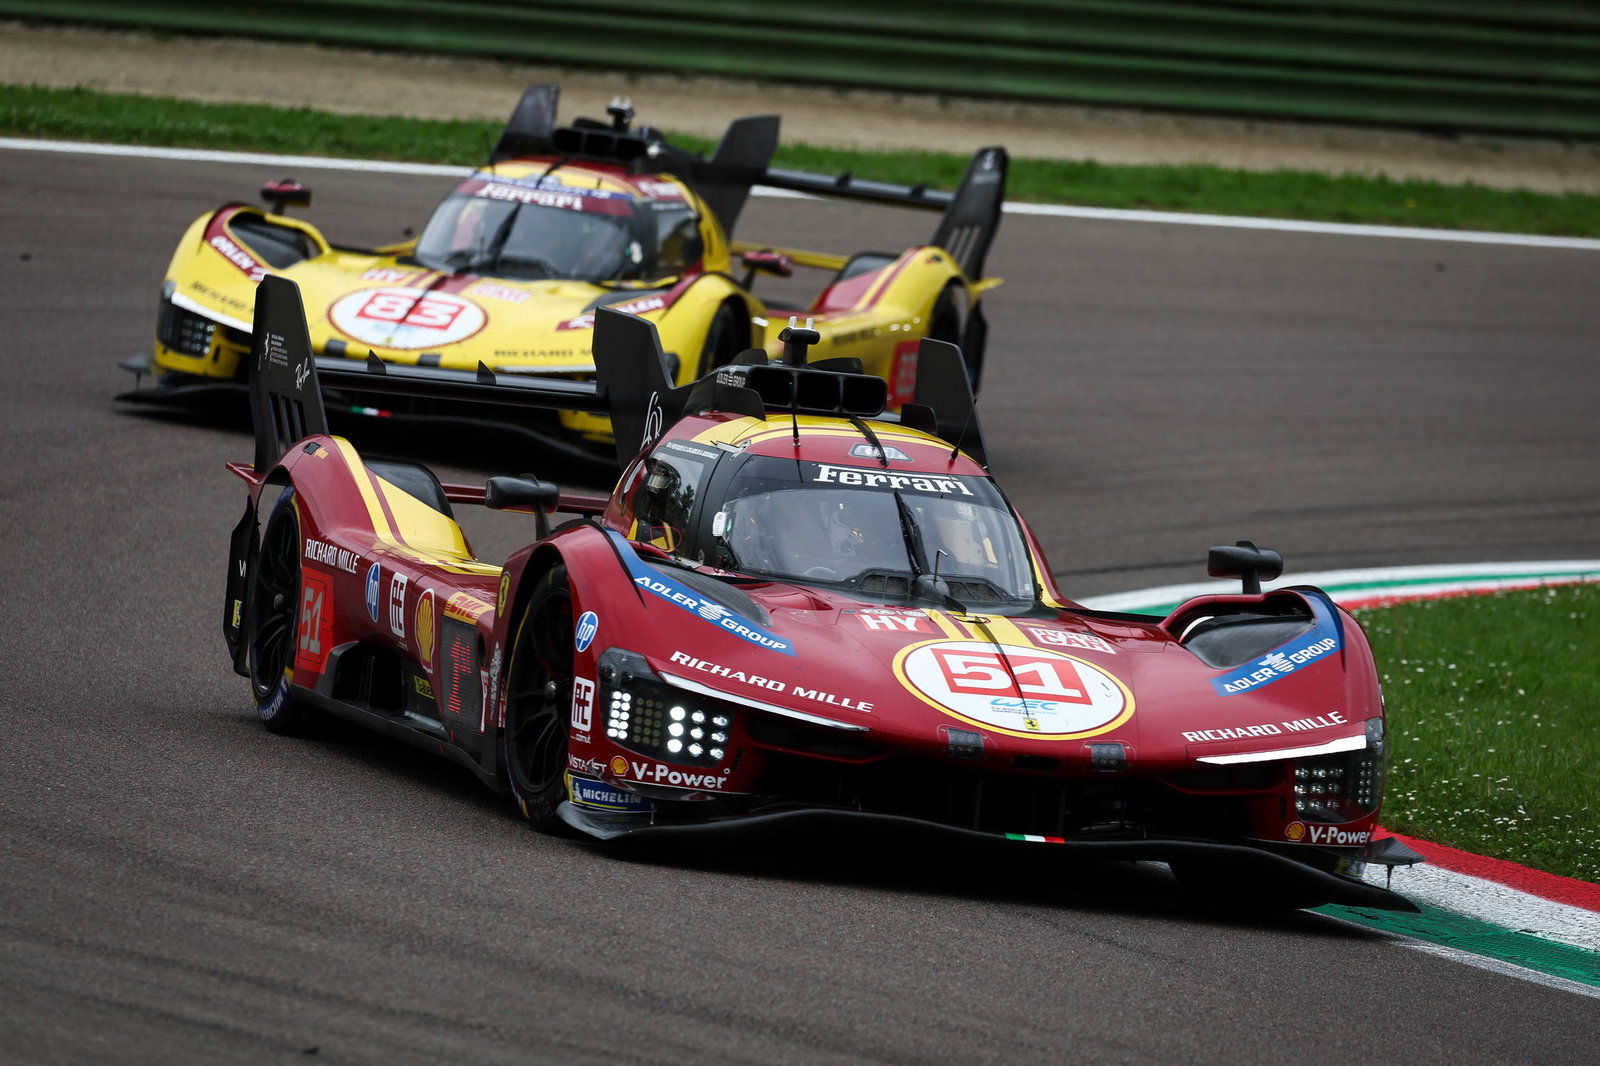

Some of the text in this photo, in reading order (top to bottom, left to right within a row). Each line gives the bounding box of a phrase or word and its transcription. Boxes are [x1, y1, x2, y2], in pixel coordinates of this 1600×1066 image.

[475, 182, 584, 212] Ferrari
[363, 294, 457, 330] 83
[813, 464, 974, 496] Ferrari
[305, 538, 360, 574] RICHARD MILLE
[300, 586, 324, 654] 51
[634, 576, 788, 650] ADLER GROUP
[860, 614, 918, 631] HY
[1040, 634, 1110, 652] CAR
[942, 653, 1083, 698] 51
[1223, 637, 1337, 693] ADLER GROUP
[670, 650, 875, 713] RICHARD MILLE
[990, 698, 1058, 711] WEC
[1181, 711, 1348, 743] RICHARD MILLE
[631, 761, 727, 789] V-Power
[582, 788, 642, 804] MICHELIN
[1309, 825, 1370, 844] V-Power
